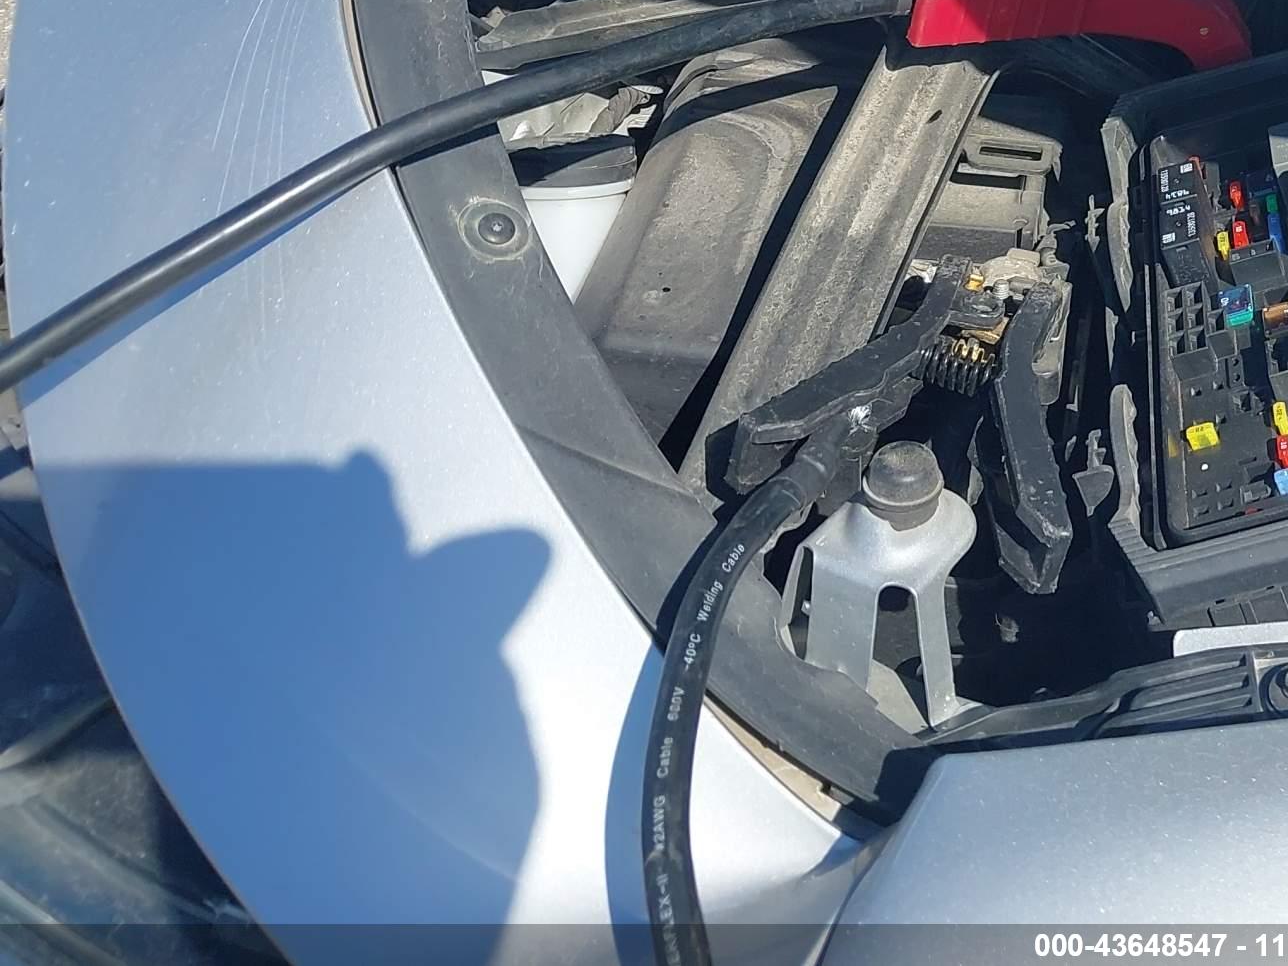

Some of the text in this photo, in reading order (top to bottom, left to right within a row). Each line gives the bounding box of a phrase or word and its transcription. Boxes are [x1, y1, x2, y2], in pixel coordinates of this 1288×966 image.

[657, 737, 673, 779] Cable
[667, 686, 685, 722] 600V
[696, 579, 724, 622] Welding
[722, 544, 745, 573] Cable
